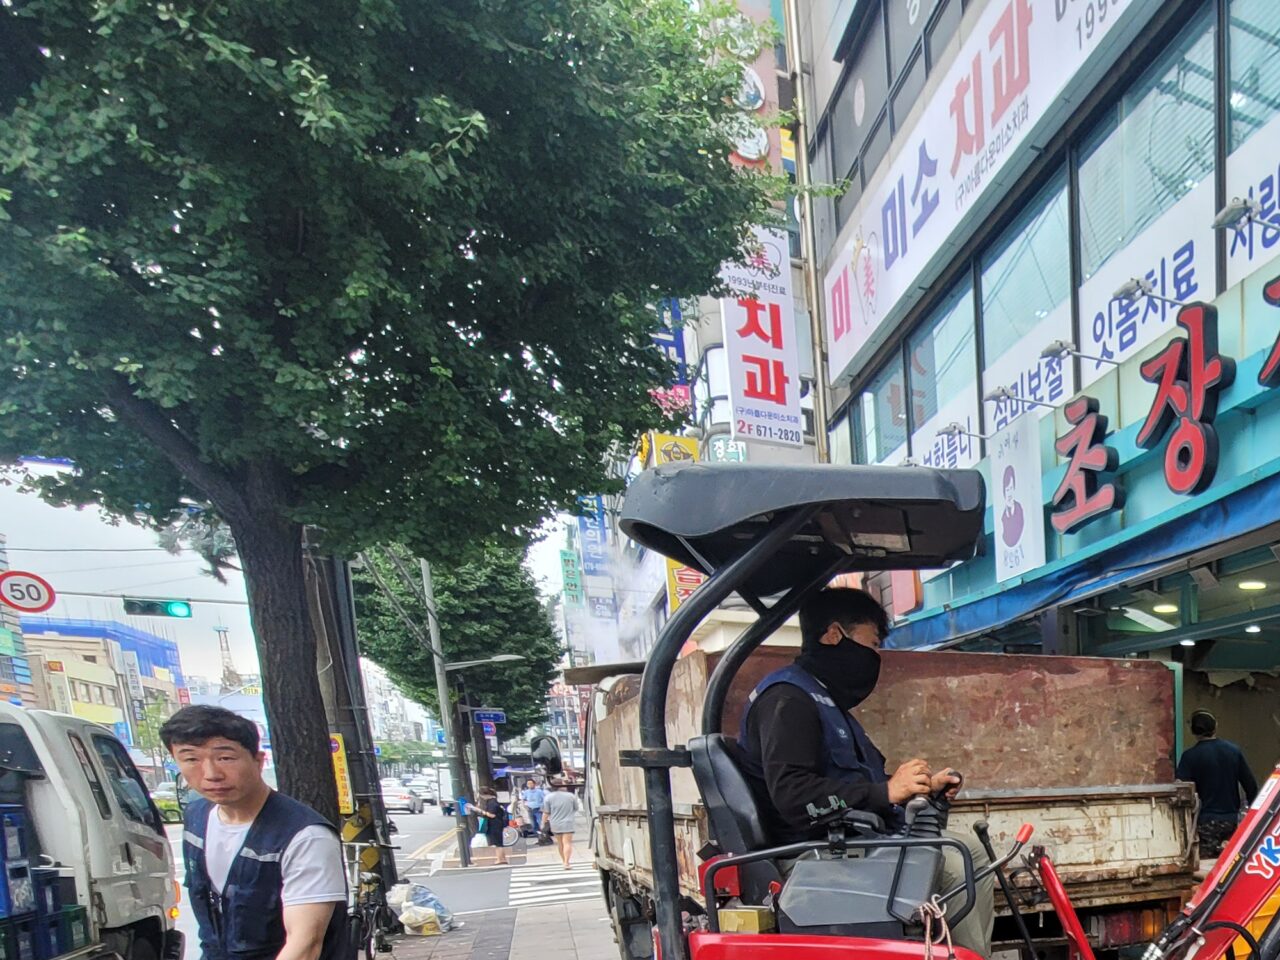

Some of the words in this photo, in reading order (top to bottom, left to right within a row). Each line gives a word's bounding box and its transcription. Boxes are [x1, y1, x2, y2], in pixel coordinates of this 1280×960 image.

[881, 139, 940, 271] 미소
[949, 0, 1032, 180] 치과
[737, 298, 790, 406] 치과
[1093, 240, 1198, 370] 잇몸치료
[737, 419, 753, 435] 2F
[756, 424, 800, 443] 671-2820
[9, 583, 42, 602] 50
